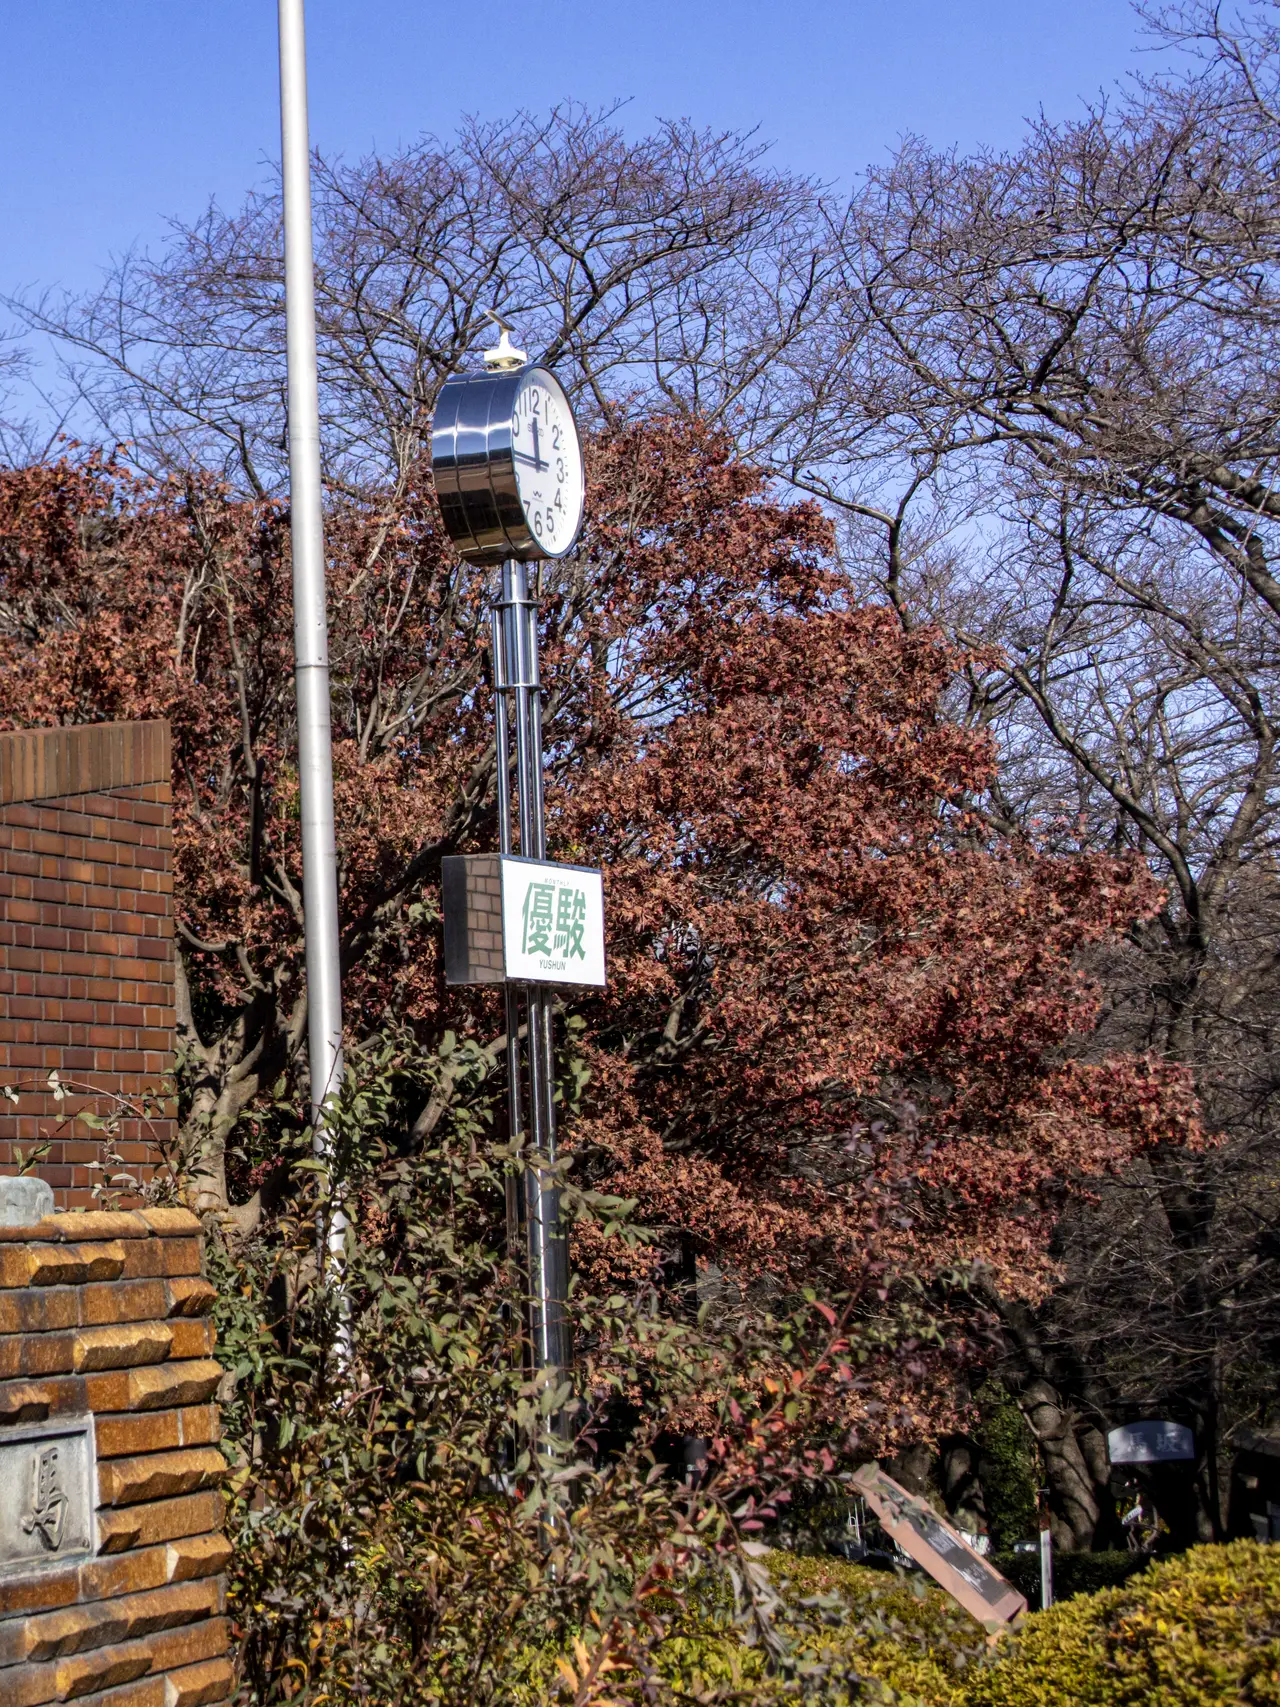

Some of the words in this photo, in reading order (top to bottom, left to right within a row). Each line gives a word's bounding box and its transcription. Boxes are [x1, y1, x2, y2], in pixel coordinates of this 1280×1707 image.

[528, 386, 540, 416] 12
[552, 424, 560, 450] 2
[556, 457, 565, 484] 3
[553, 488, 562, 513] 4
[534, 511, 543, 537] 6
[546, 507, 555, 533] 5
[522, 882, 586, 961] 優駿
[539, 960, 566, 970] YUSHUN
